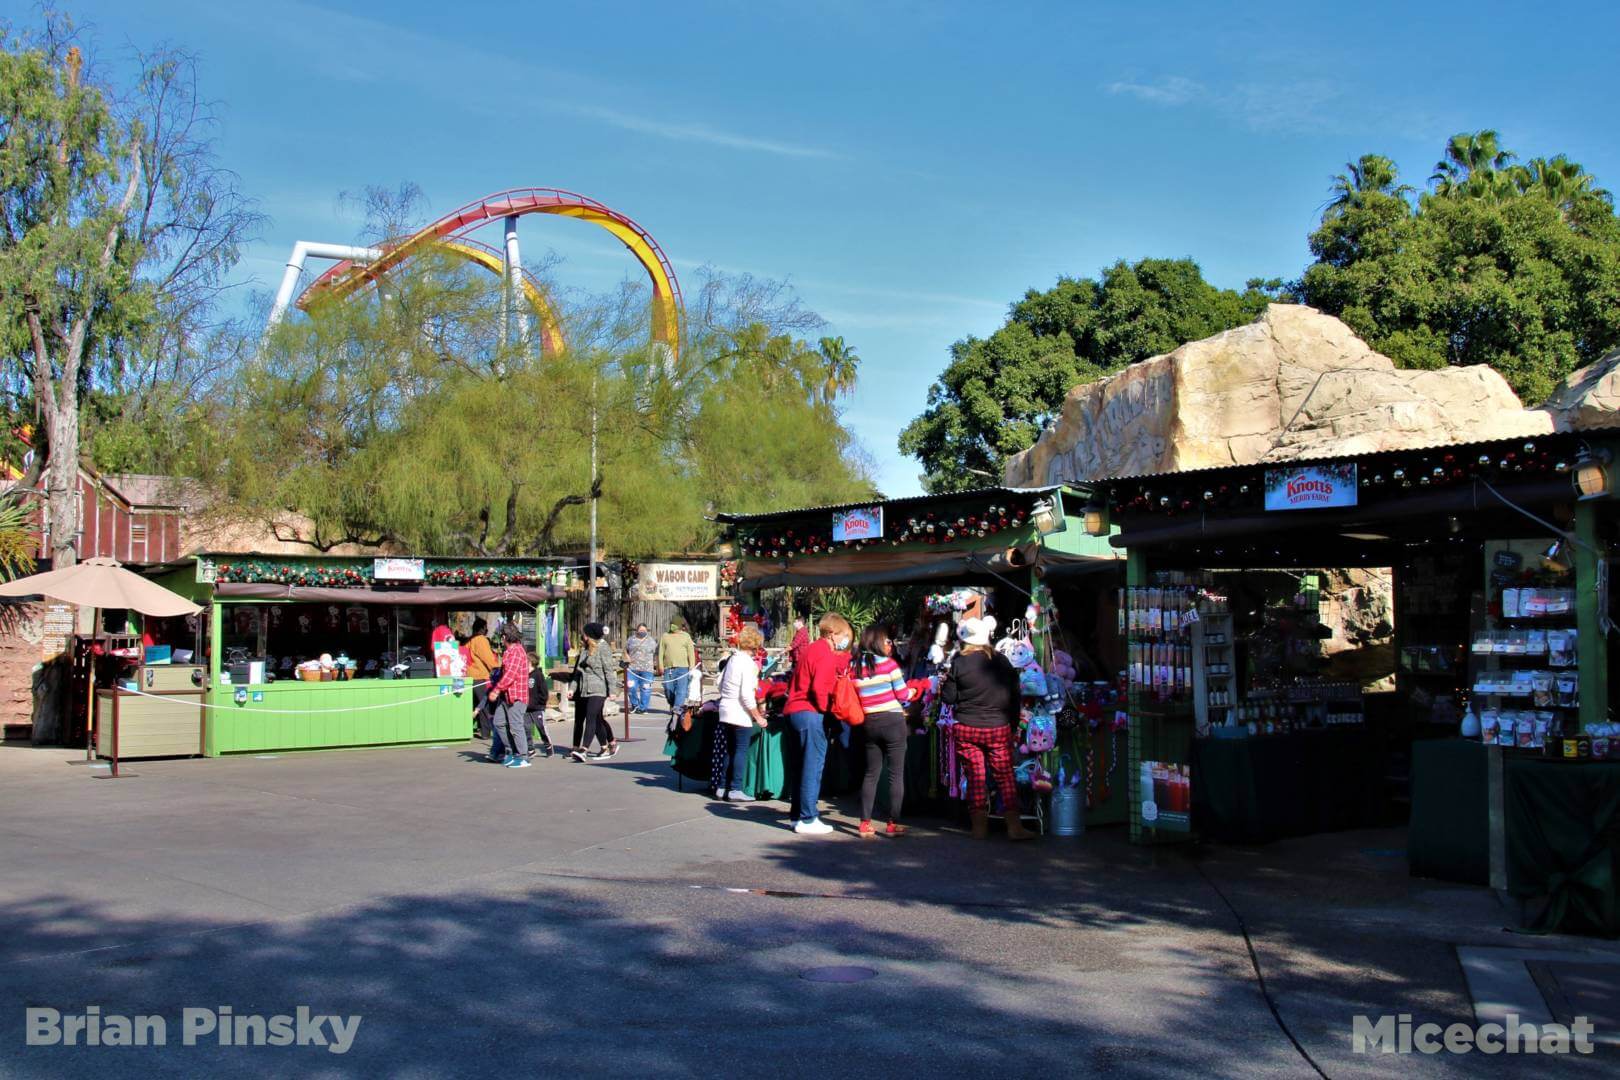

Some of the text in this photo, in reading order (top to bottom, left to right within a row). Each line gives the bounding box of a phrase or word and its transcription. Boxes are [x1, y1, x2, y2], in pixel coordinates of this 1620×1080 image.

[1287, 474, 1333, 497] Knott's
[656, 569, 710, 584] WAGON CAMP
